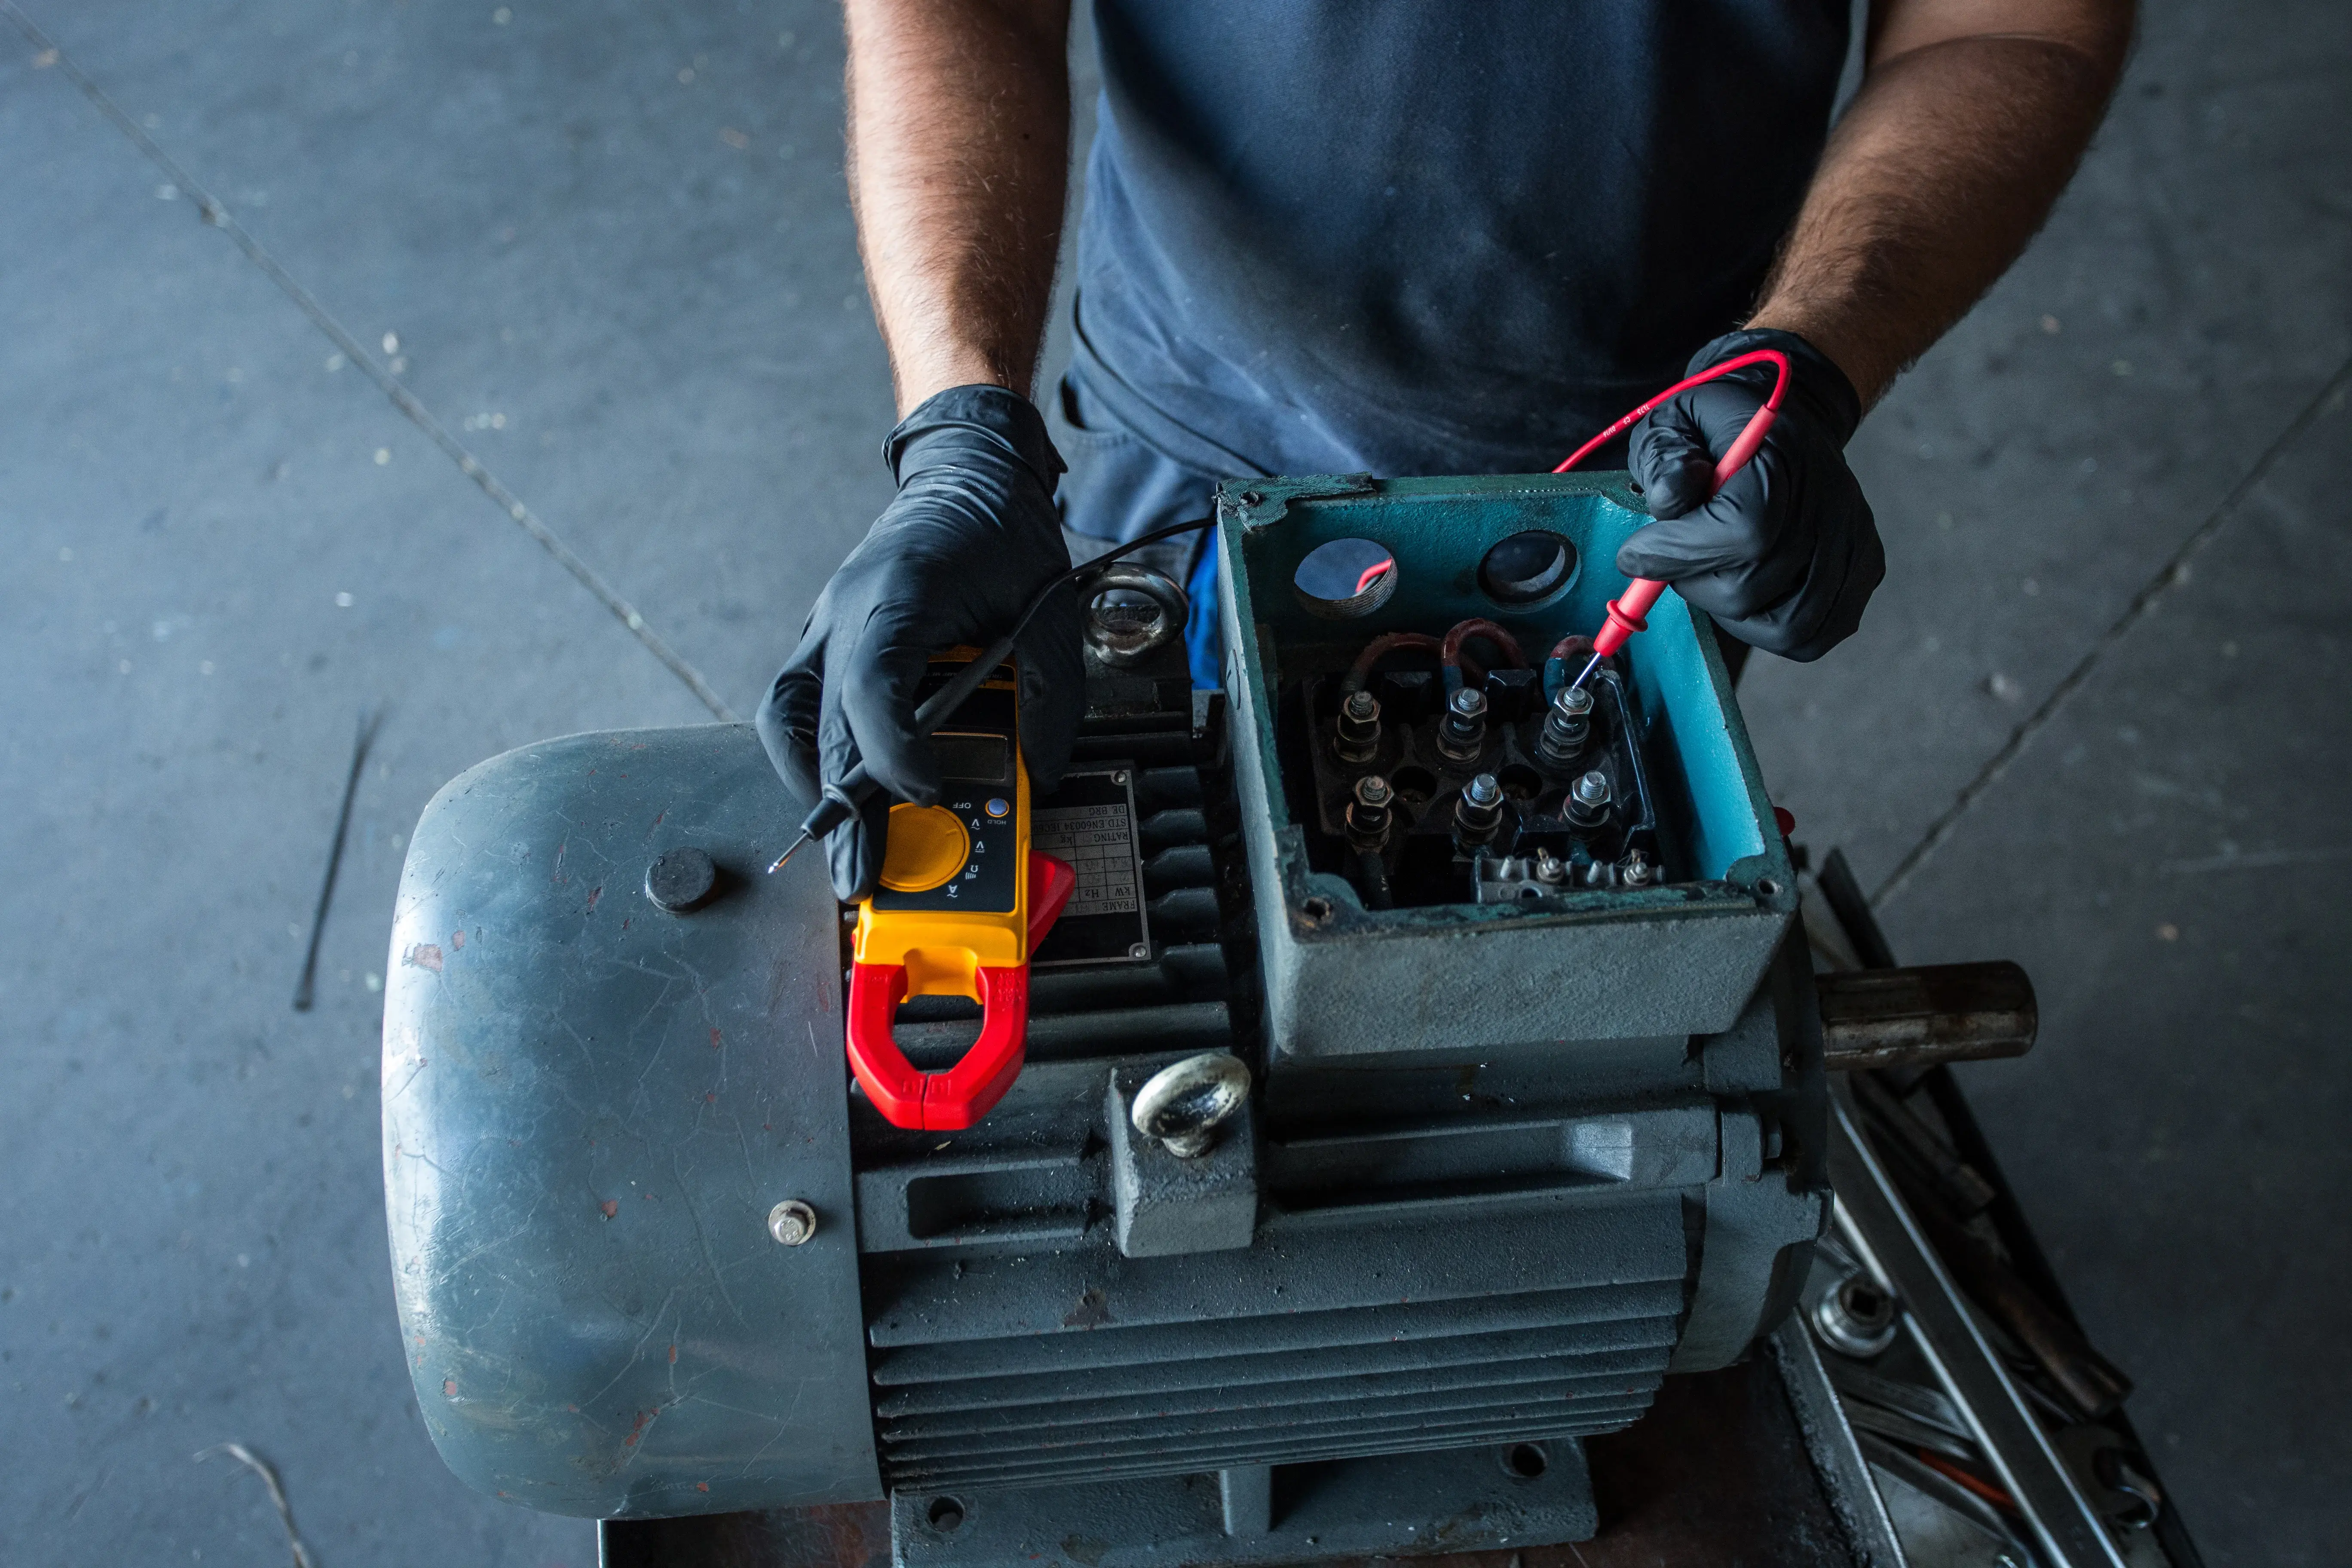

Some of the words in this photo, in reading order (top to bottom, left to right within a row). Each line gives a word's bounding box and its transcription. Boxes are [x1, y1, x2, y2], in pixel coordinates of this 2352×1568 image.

[1089, 806, 1107, 816] BRG
[1112, 805, 1125, 814] DE
[1060, 835, 1072, 845] kg
[1093, 832, 1129, 842] RATING
[1085, 889, 1099, 898] Hz
[1115, 887, 1130, 896] kW
[1102, 900, 1136, 911] FRAME
